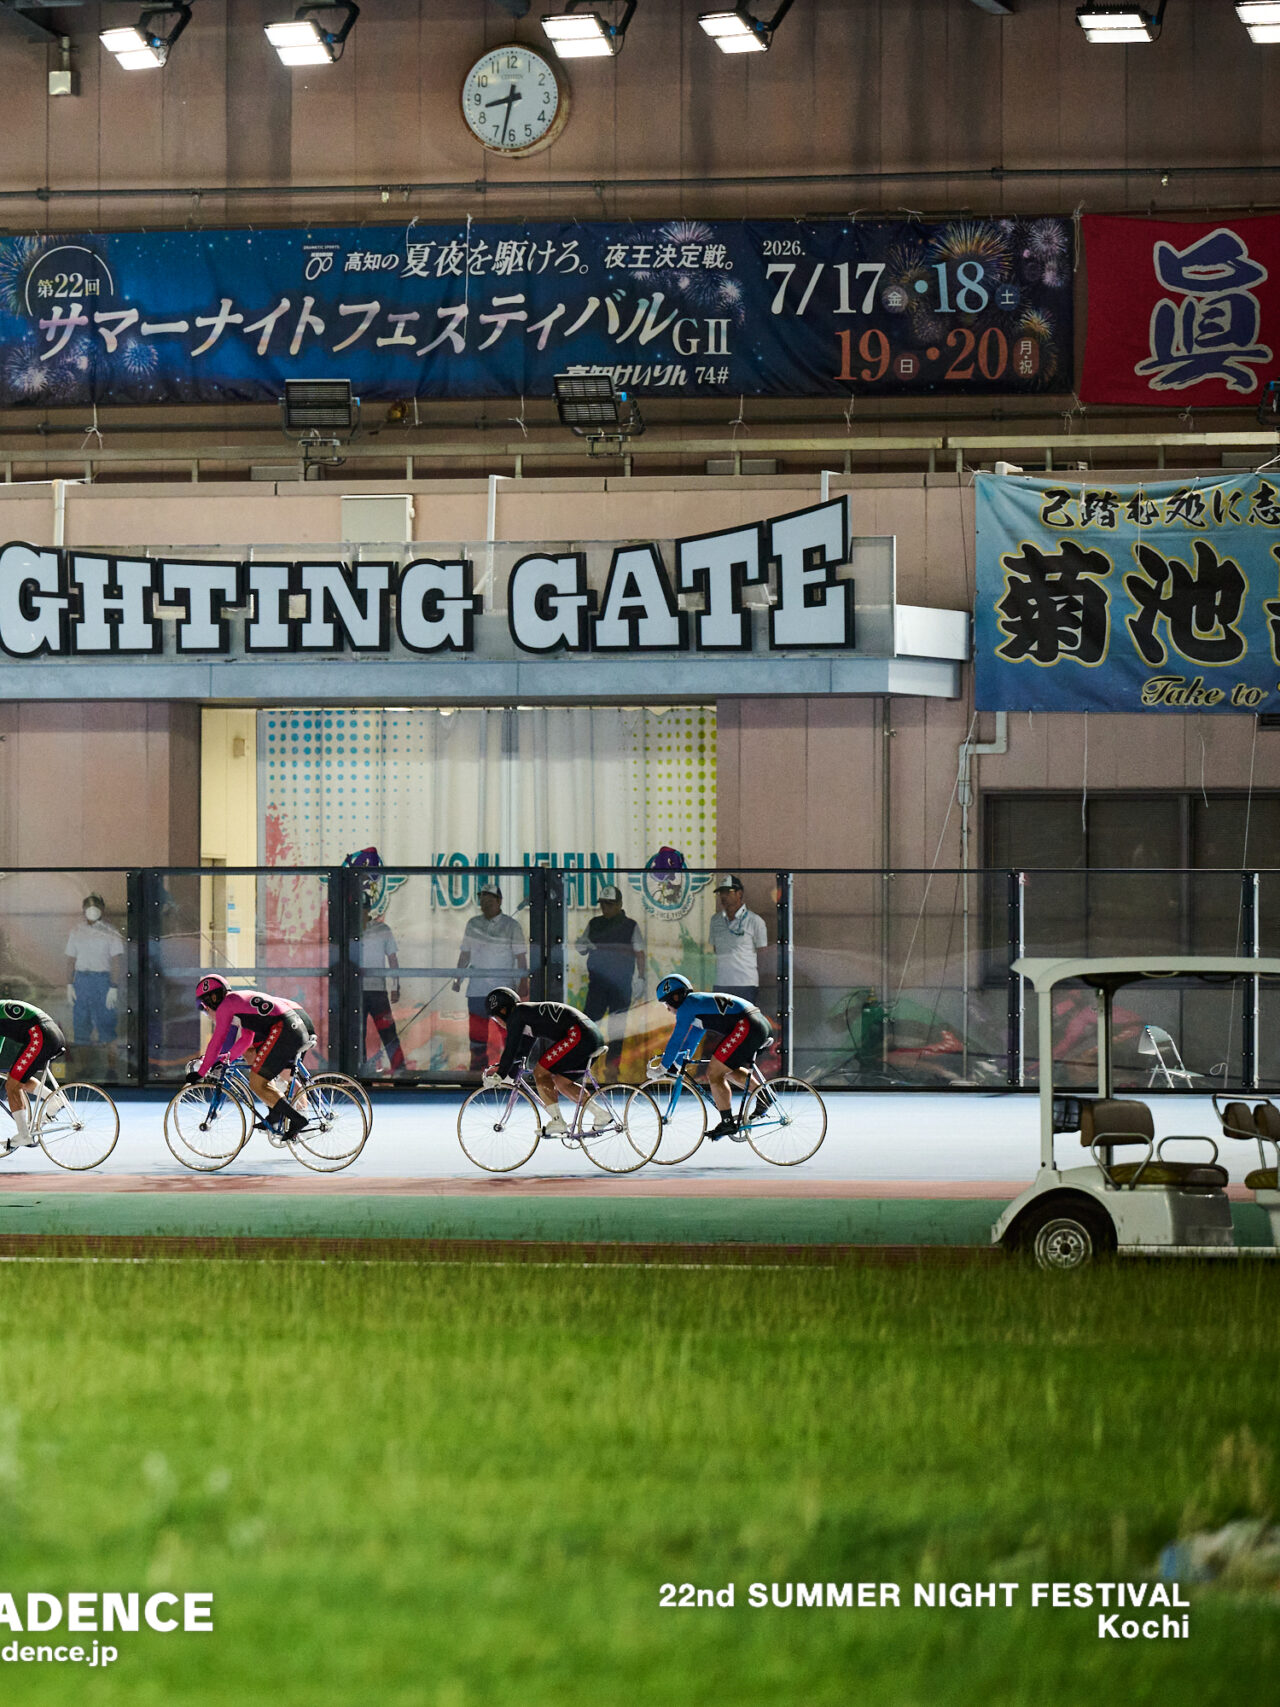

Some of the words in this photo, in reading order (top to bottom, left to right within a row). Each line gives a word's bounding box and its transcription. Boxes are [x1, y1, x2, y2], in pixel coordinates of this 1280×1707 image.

[491, 60, 499, 74] 11
[506, 55, 518, 69] 12
[477, 75, 488, 88] 10
[538, 73, 545, 86] 2
[474, 93, 482, 105] 9
[542, 91, 551, 104] 3
[478, 112, 486, 124] 8
[537, 110, 546, 122] 4
[492, 125, 500, 137] 7
[508, 129, 516, 142] 6
[524, 124, 532, 137] 5
[762, 240, 806, 256] 2026.
[344, 240, 589, 278] 高知の夏夜を駆けろ。
[603, 244, 734, 270] 夜王決定戦。
[37, 273, 101, 299] 第22回
[765, 262, 886, 316] 7/17
[887, 291, 902, 307] 金
[1001, 289, 1014, 305] 土
[38, 287, 678, 361] サマーナイトフェスティバル
[833, 328, 891, 382] 19
[900, 359, 913, 374] 日
[695, 366, 729, 385] 74#
[507, 494, 856, 656] GATE
[996, 538, 1280, 668] 菊池
[1141, 675, 1225, 707] Take
[1230, 682, 1267, 707] to
[662, 979, 671, 993] 4
[4, 1001, 25, 1020] 6
[250, 996, 274, 1016] 8
[713, 995, 735, 1015] 4
